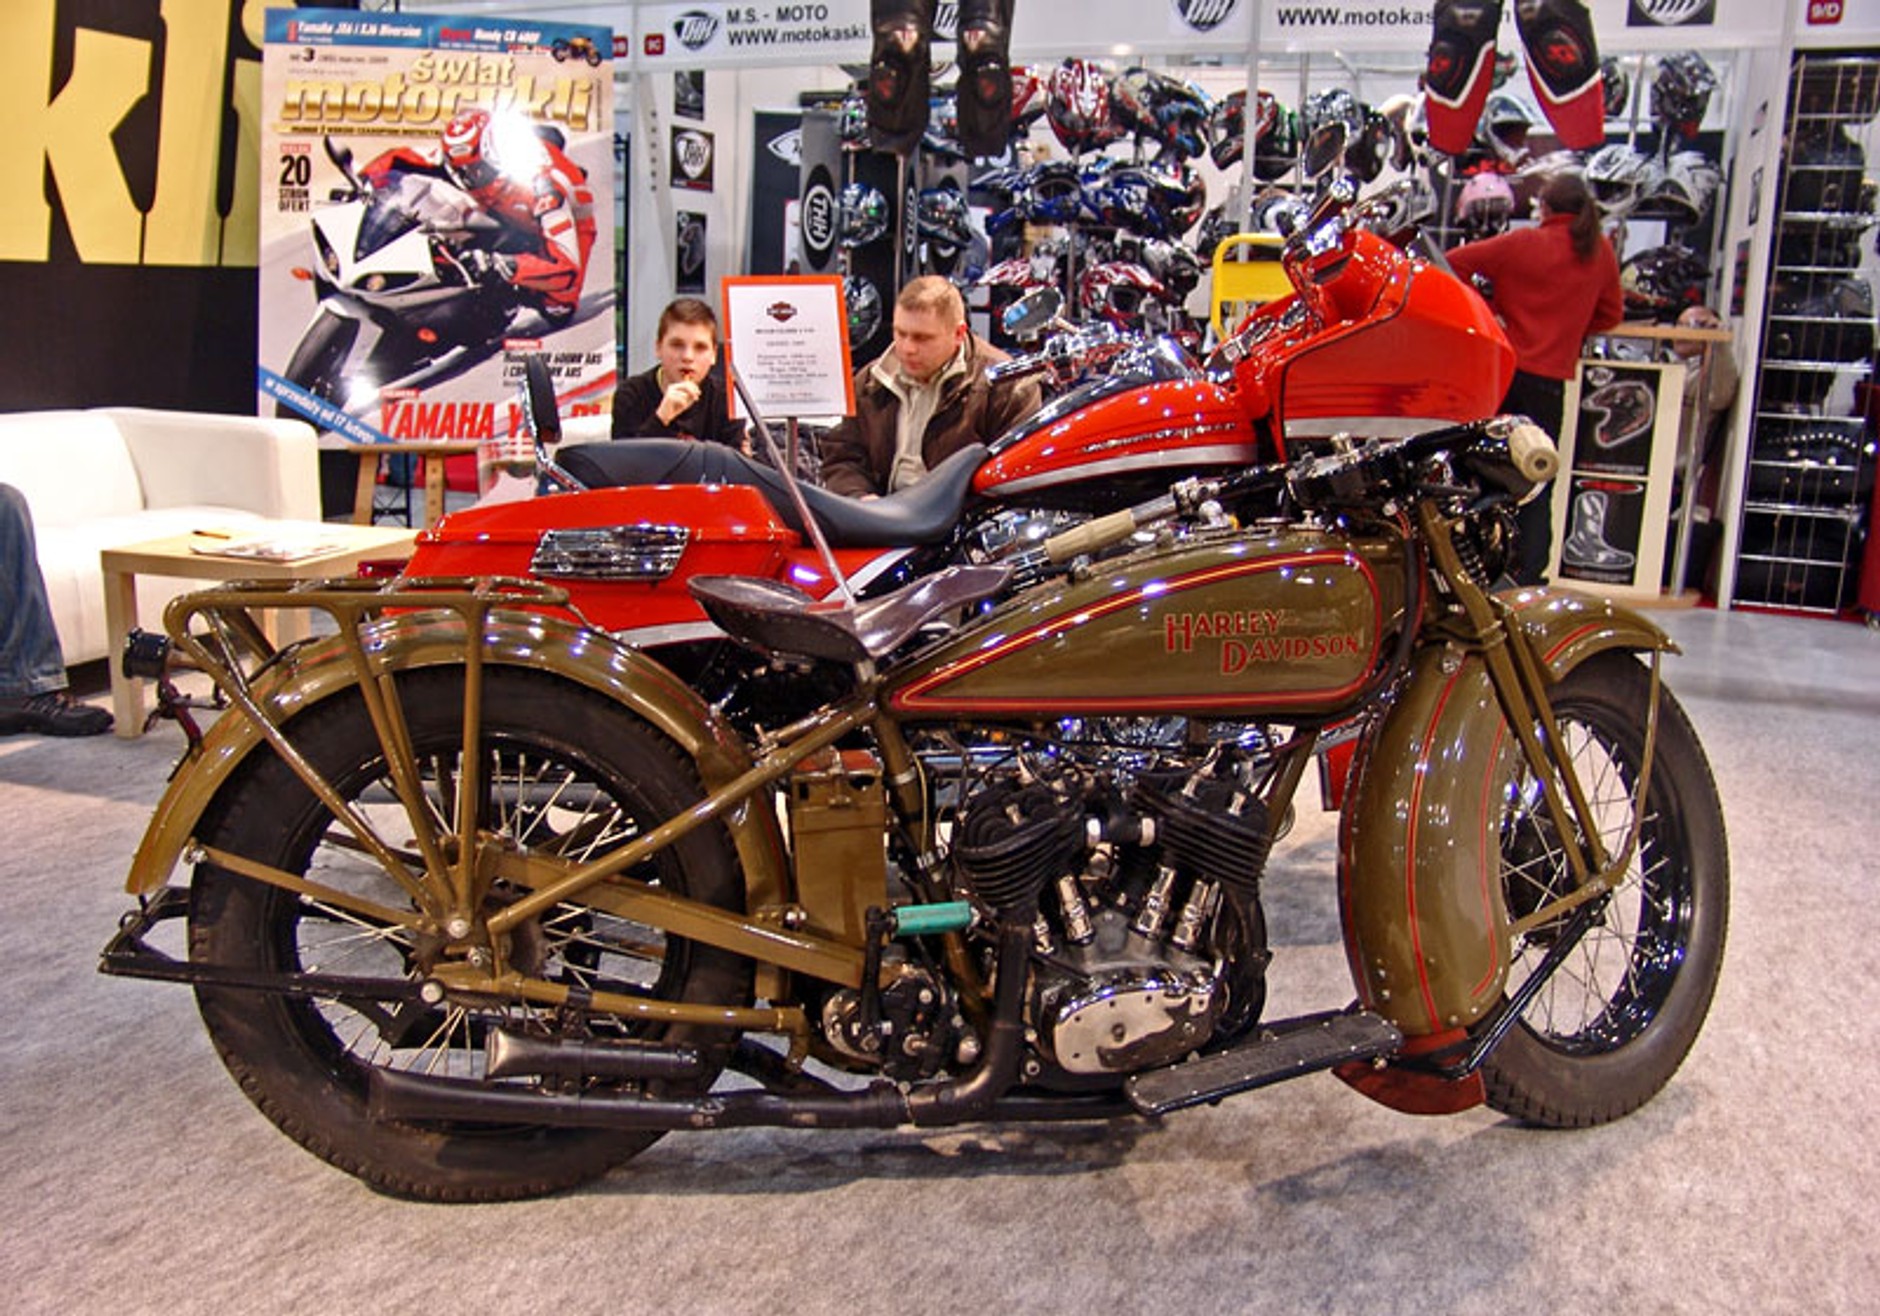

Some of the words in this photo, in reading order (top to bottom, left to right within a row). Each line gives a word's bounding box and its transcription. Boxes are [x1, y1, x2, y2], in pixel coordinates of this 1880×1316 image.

[727, 9, 759, 24] M.S.
[776, 5, 828, 22] MOTO
[302, 47, 315, 63] 3
[411, 51, 516, 86] świat
[280, 154, 311, 186] 20
[809, 196, 829, 241] THH
[380, 401, 496, 440] YAMAHA
[1164, 609, 1282, 652] HARLEY
[1221, 635, 1362, 675] DAVIDSON
